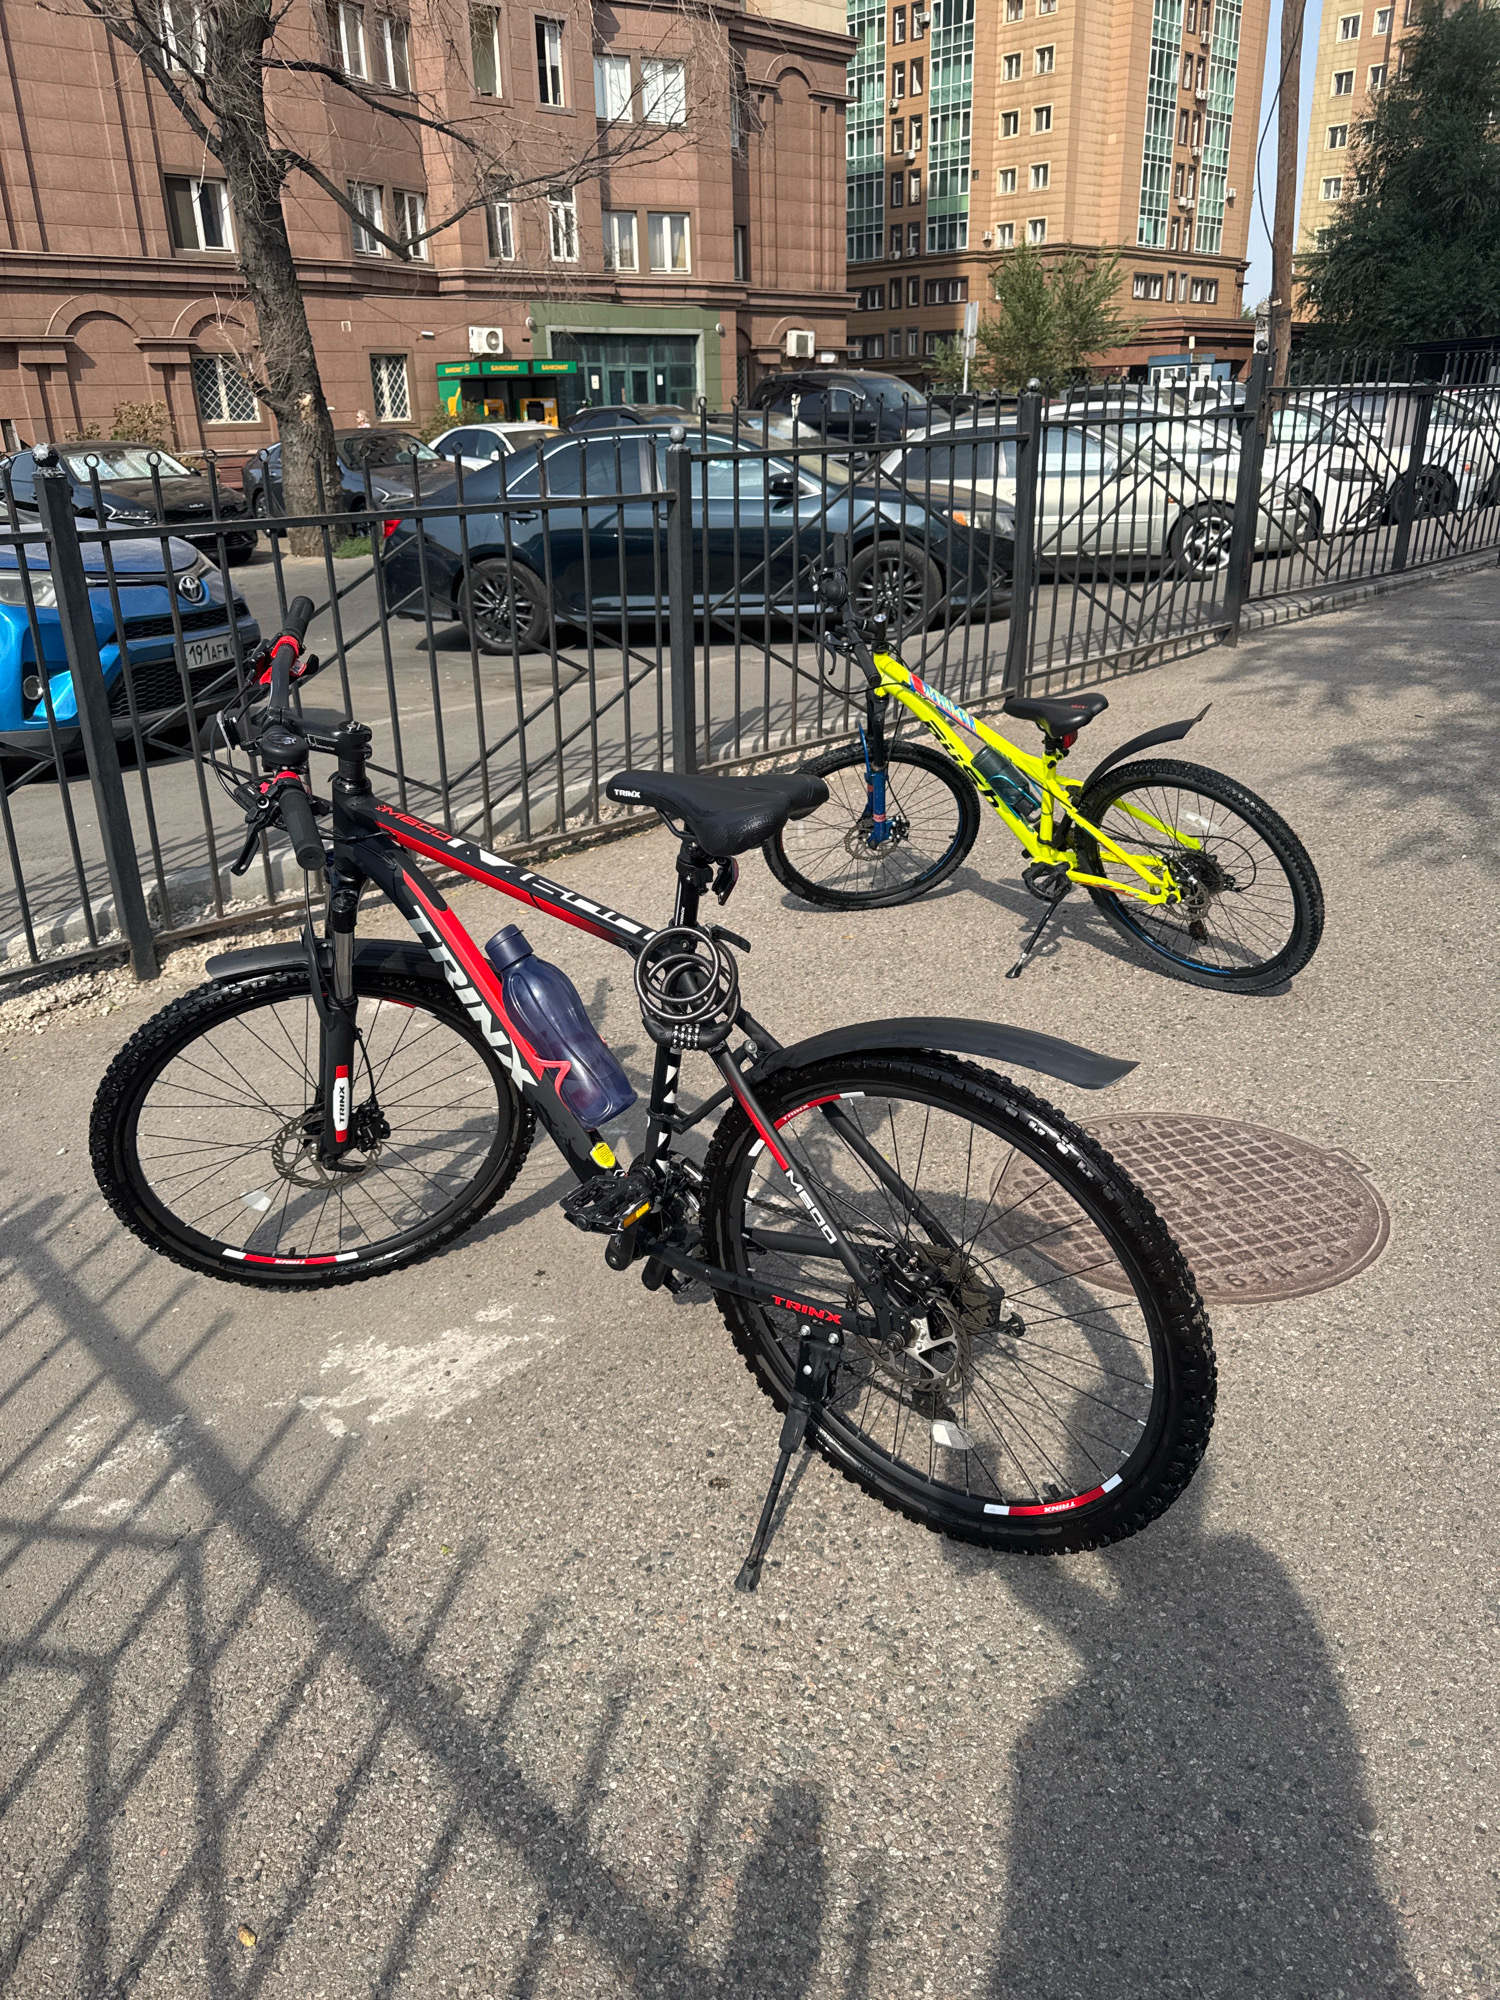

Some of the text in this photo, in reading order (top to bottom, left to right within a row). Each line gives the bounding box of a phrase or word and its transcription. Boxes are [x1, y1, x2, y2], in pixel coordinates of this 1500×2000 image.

[613, 788, 641, 799] TRINX
[407, 904, 539, 1093] TRINX
[782, 1104, 810, 1121] TRINX
[771, 1294, 842, 1326] TRINX
[1043, 1501, 1077, 1513] TRINX
